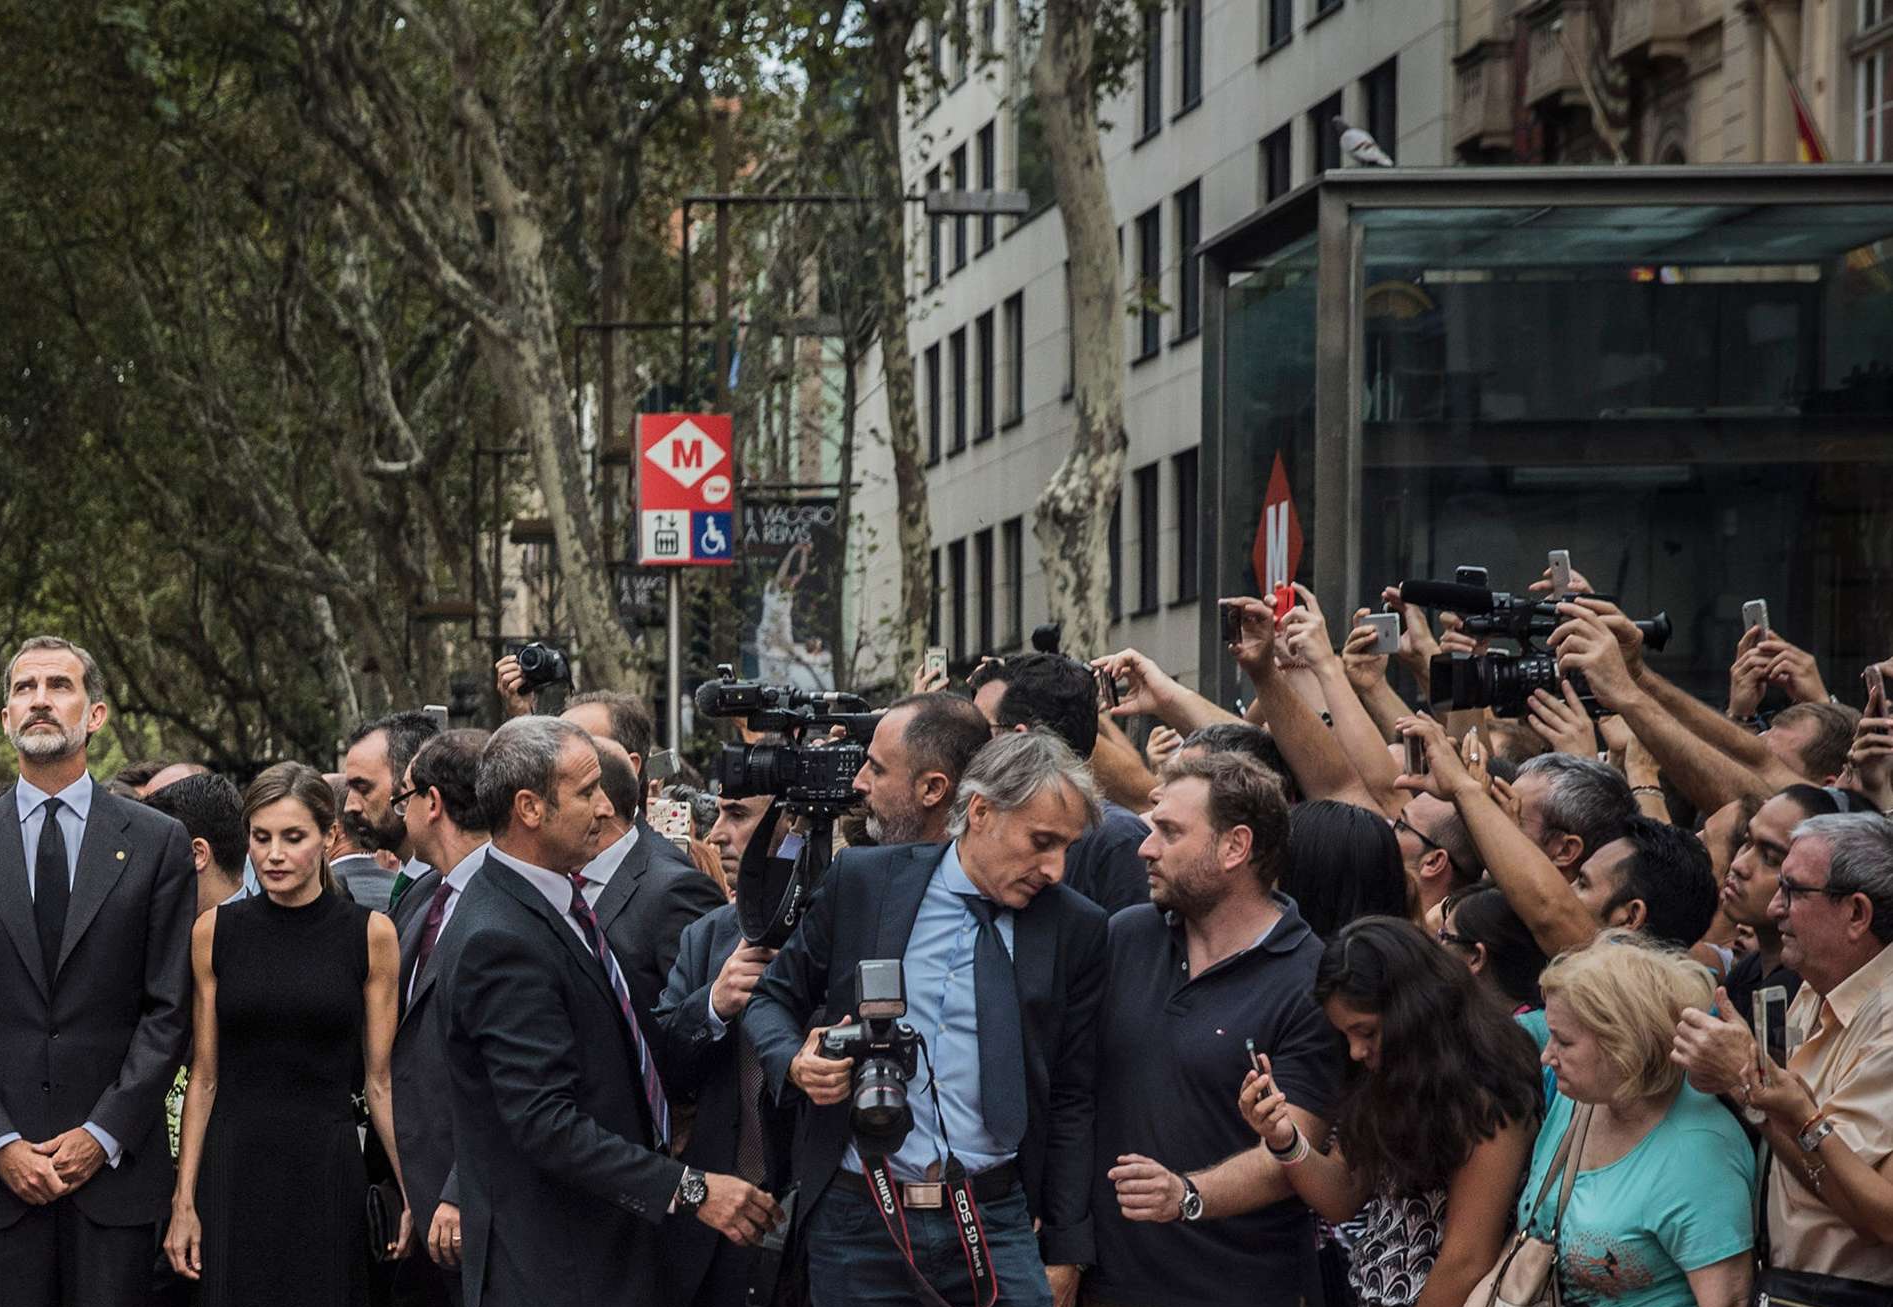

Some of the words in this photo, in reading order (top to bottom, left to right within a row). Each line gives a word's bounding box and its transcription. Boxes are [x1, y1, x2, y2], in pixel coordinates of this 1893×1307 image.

[672, 440, 702, 468] M
[1266, 500, 1289, 597] M
[873, 1168, 895, 1214] Canon
[955, 1189, 974, 1224] EOS
[965, 1225, 979, 1244] 5D
